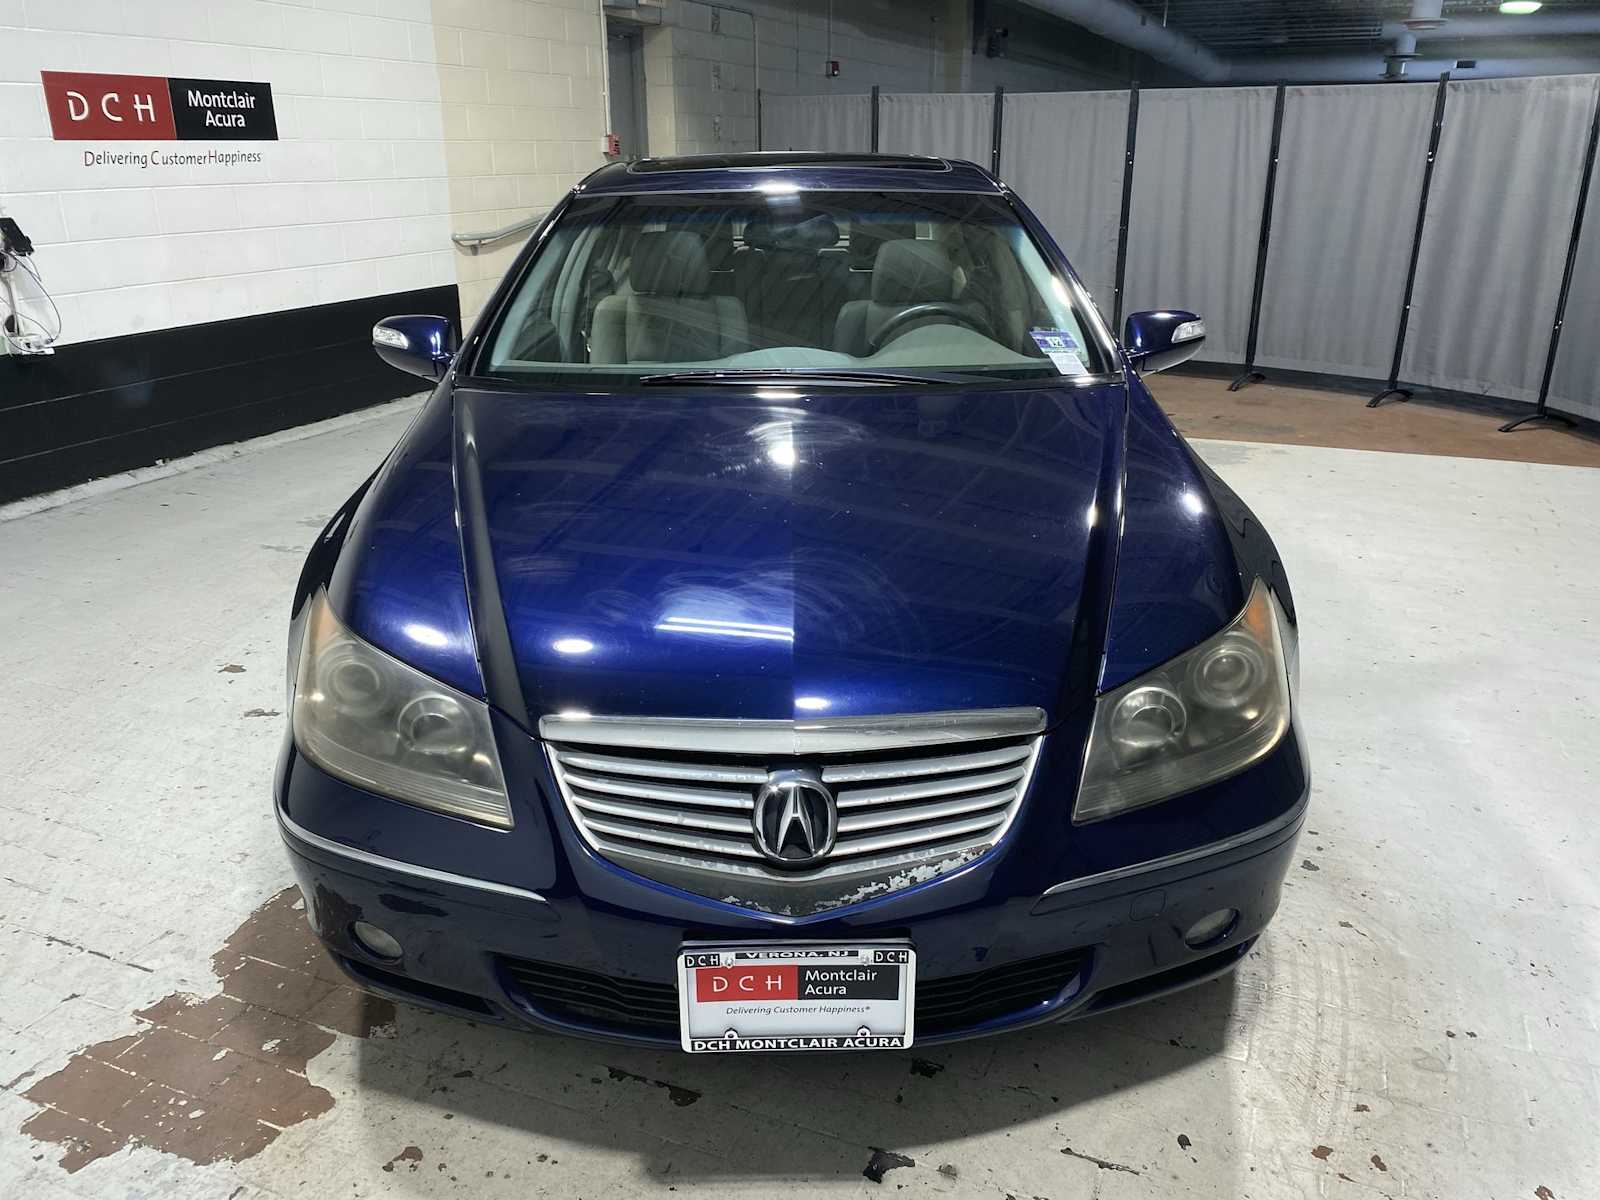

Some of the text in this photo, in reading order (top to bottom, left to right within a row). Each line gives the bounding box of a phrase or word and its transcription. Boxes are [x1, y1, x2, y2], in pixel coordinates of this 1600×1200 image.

[187, 89, 256, 109] Montclair
[66, 90, 157, 122] DCH
[205, 110, 246, 128] Acura
[84, 150, 148, 169] Delivering
[208, 149, 262, 166] Happiness
[685, 955, 720, 967] DCH
[875, 951, 908, 962] DCH
[805, 969, 877, 982] Montclair
[713, 975, 782, 992] DCH
[805, 984, 847, 995] Acura
[726, 1006, 771, 1016] Delivering
[774, 1006, 816, 1014] Customer
[694, 1037, 902, 1050] DCH MONTCLAIR ACURA
